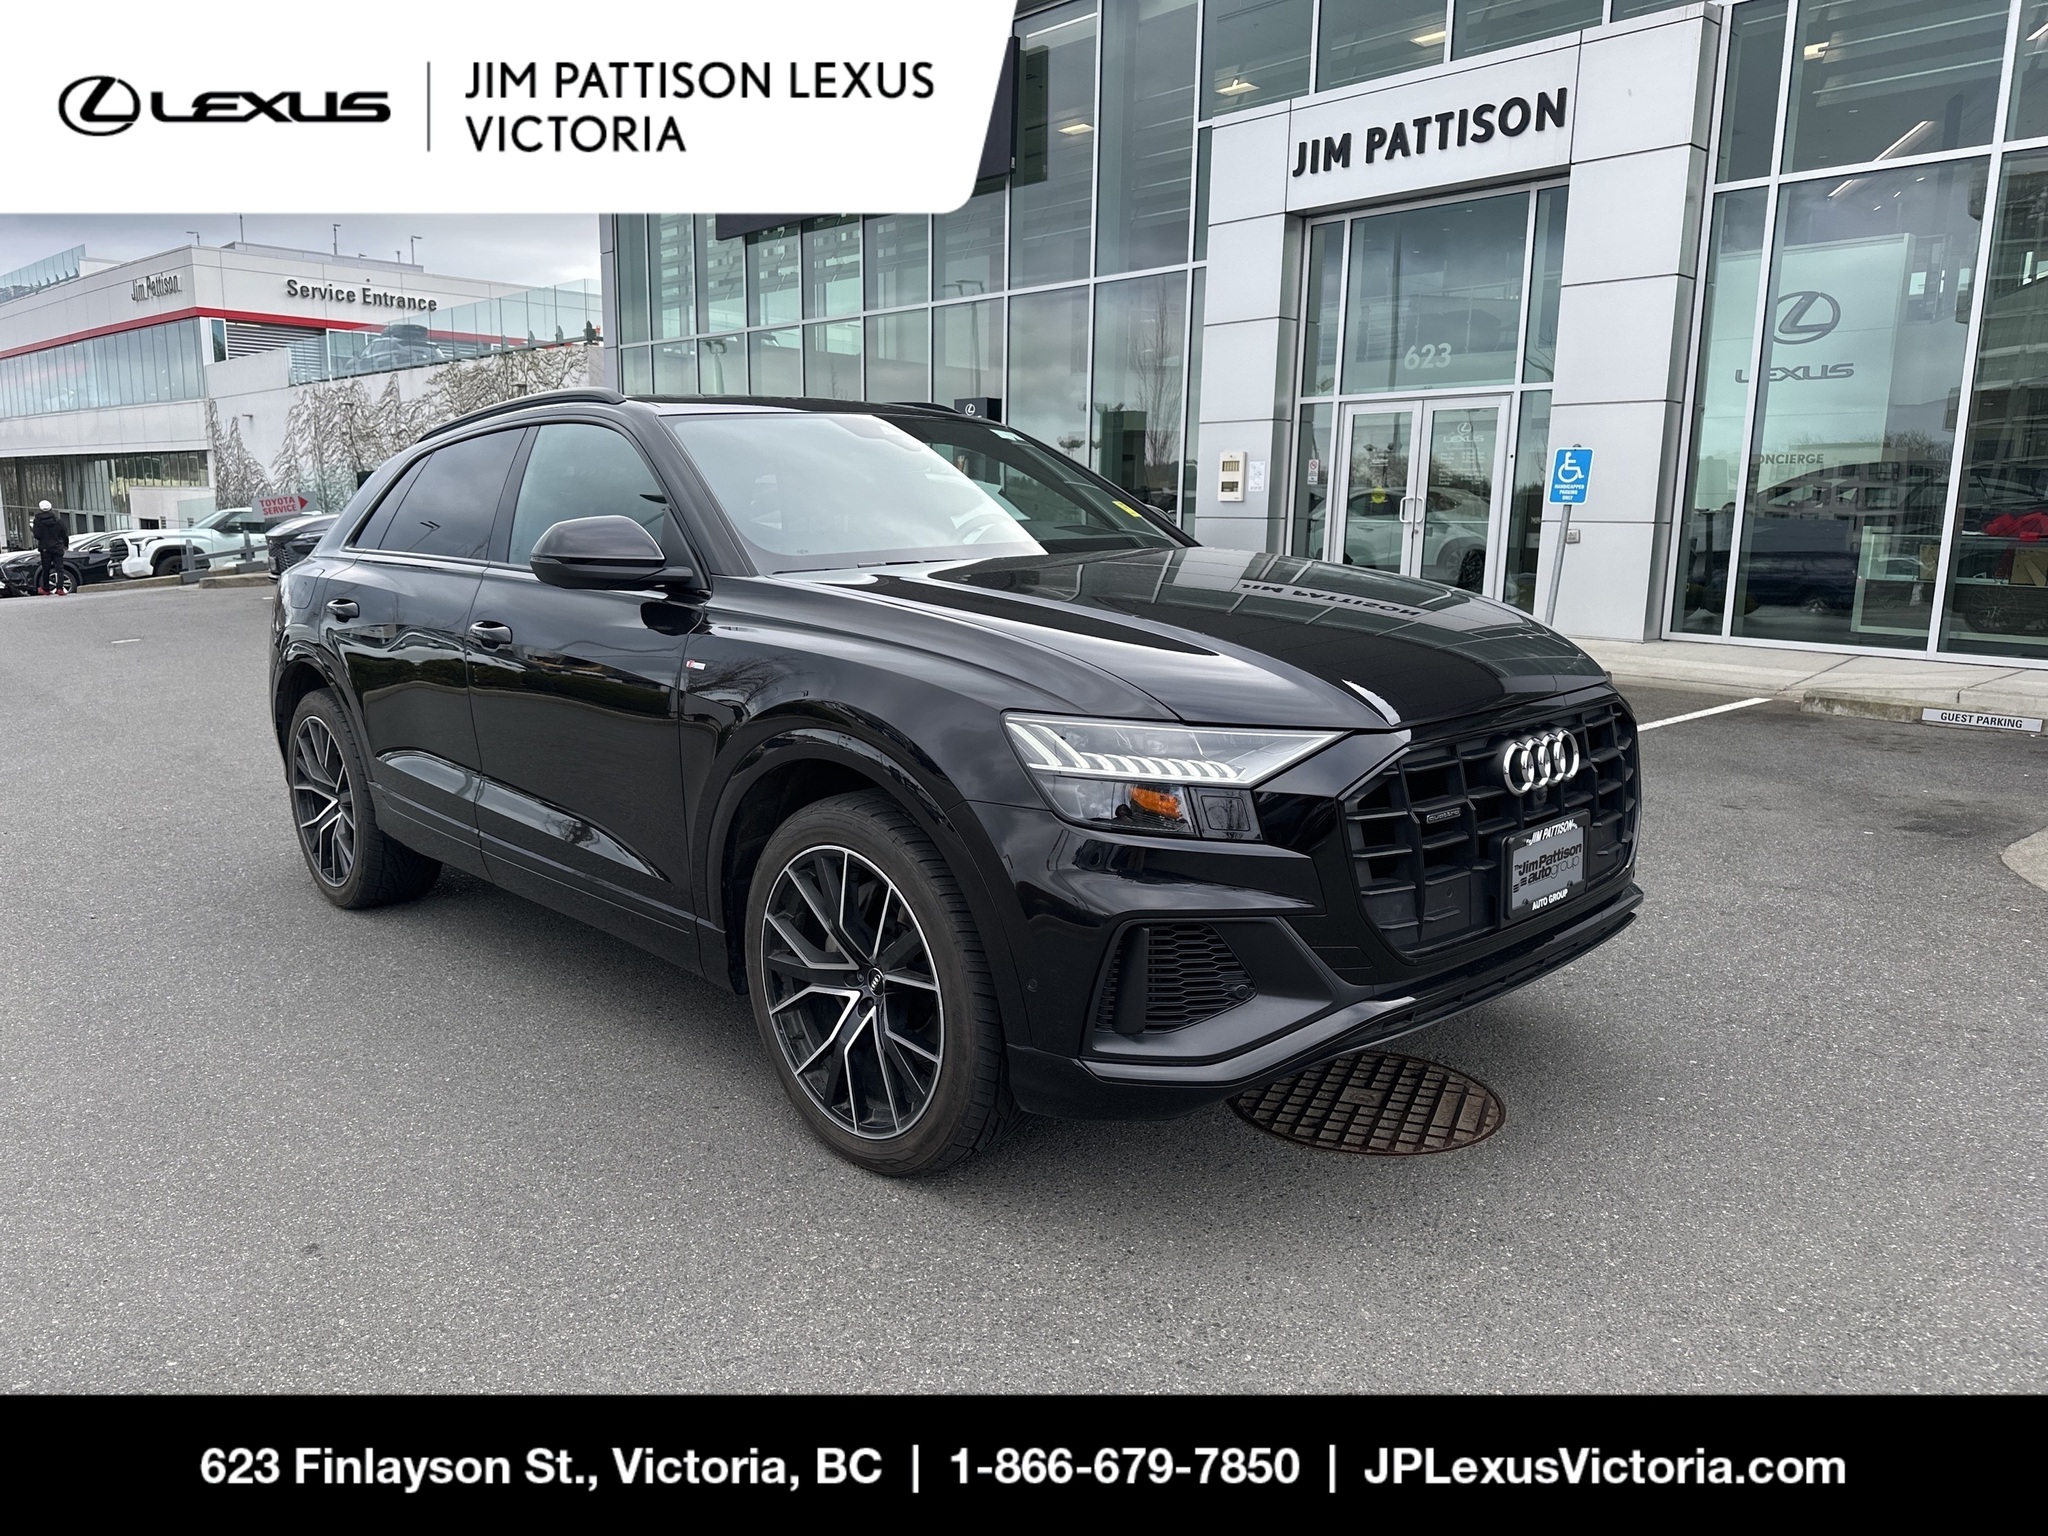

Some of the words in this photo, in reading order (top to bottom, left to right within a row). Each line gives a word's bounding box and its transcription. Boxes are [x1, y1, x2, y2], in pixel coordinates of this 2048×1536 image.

[1292, 133, 1352, 178] JIM
[1365, 87, 1568, 164] PATTISON
[131, 279, 145, 302] Jim
[146, 272, 180, 298] Pattison
[286, 279, 356, 303] Service
[361, 287, 438, 311] Entrance
[1403, 342, 1452, 370] 623
[1443, 435, 1485, 443] LEXUS
[1758, 454, 1824, 464] ONCIERGE
[259, 496, 296, 508] TOYOTA
[263, 504, 297, 516] SERVICE
[1940, 711, 1974, 724] GUEST
[1976, 715, 2023, 729] PARKING
[1530, 829, 1543, 844] JIM
[1543, 819, 1575, 839] PATTISON
[1518, 859, 1539, 877] Jim
[1539, 843, 1582, 868] Pattison
[1532, 896, 1548, 911] AUTO
[1548, 888, 1568, 904] GROUP
